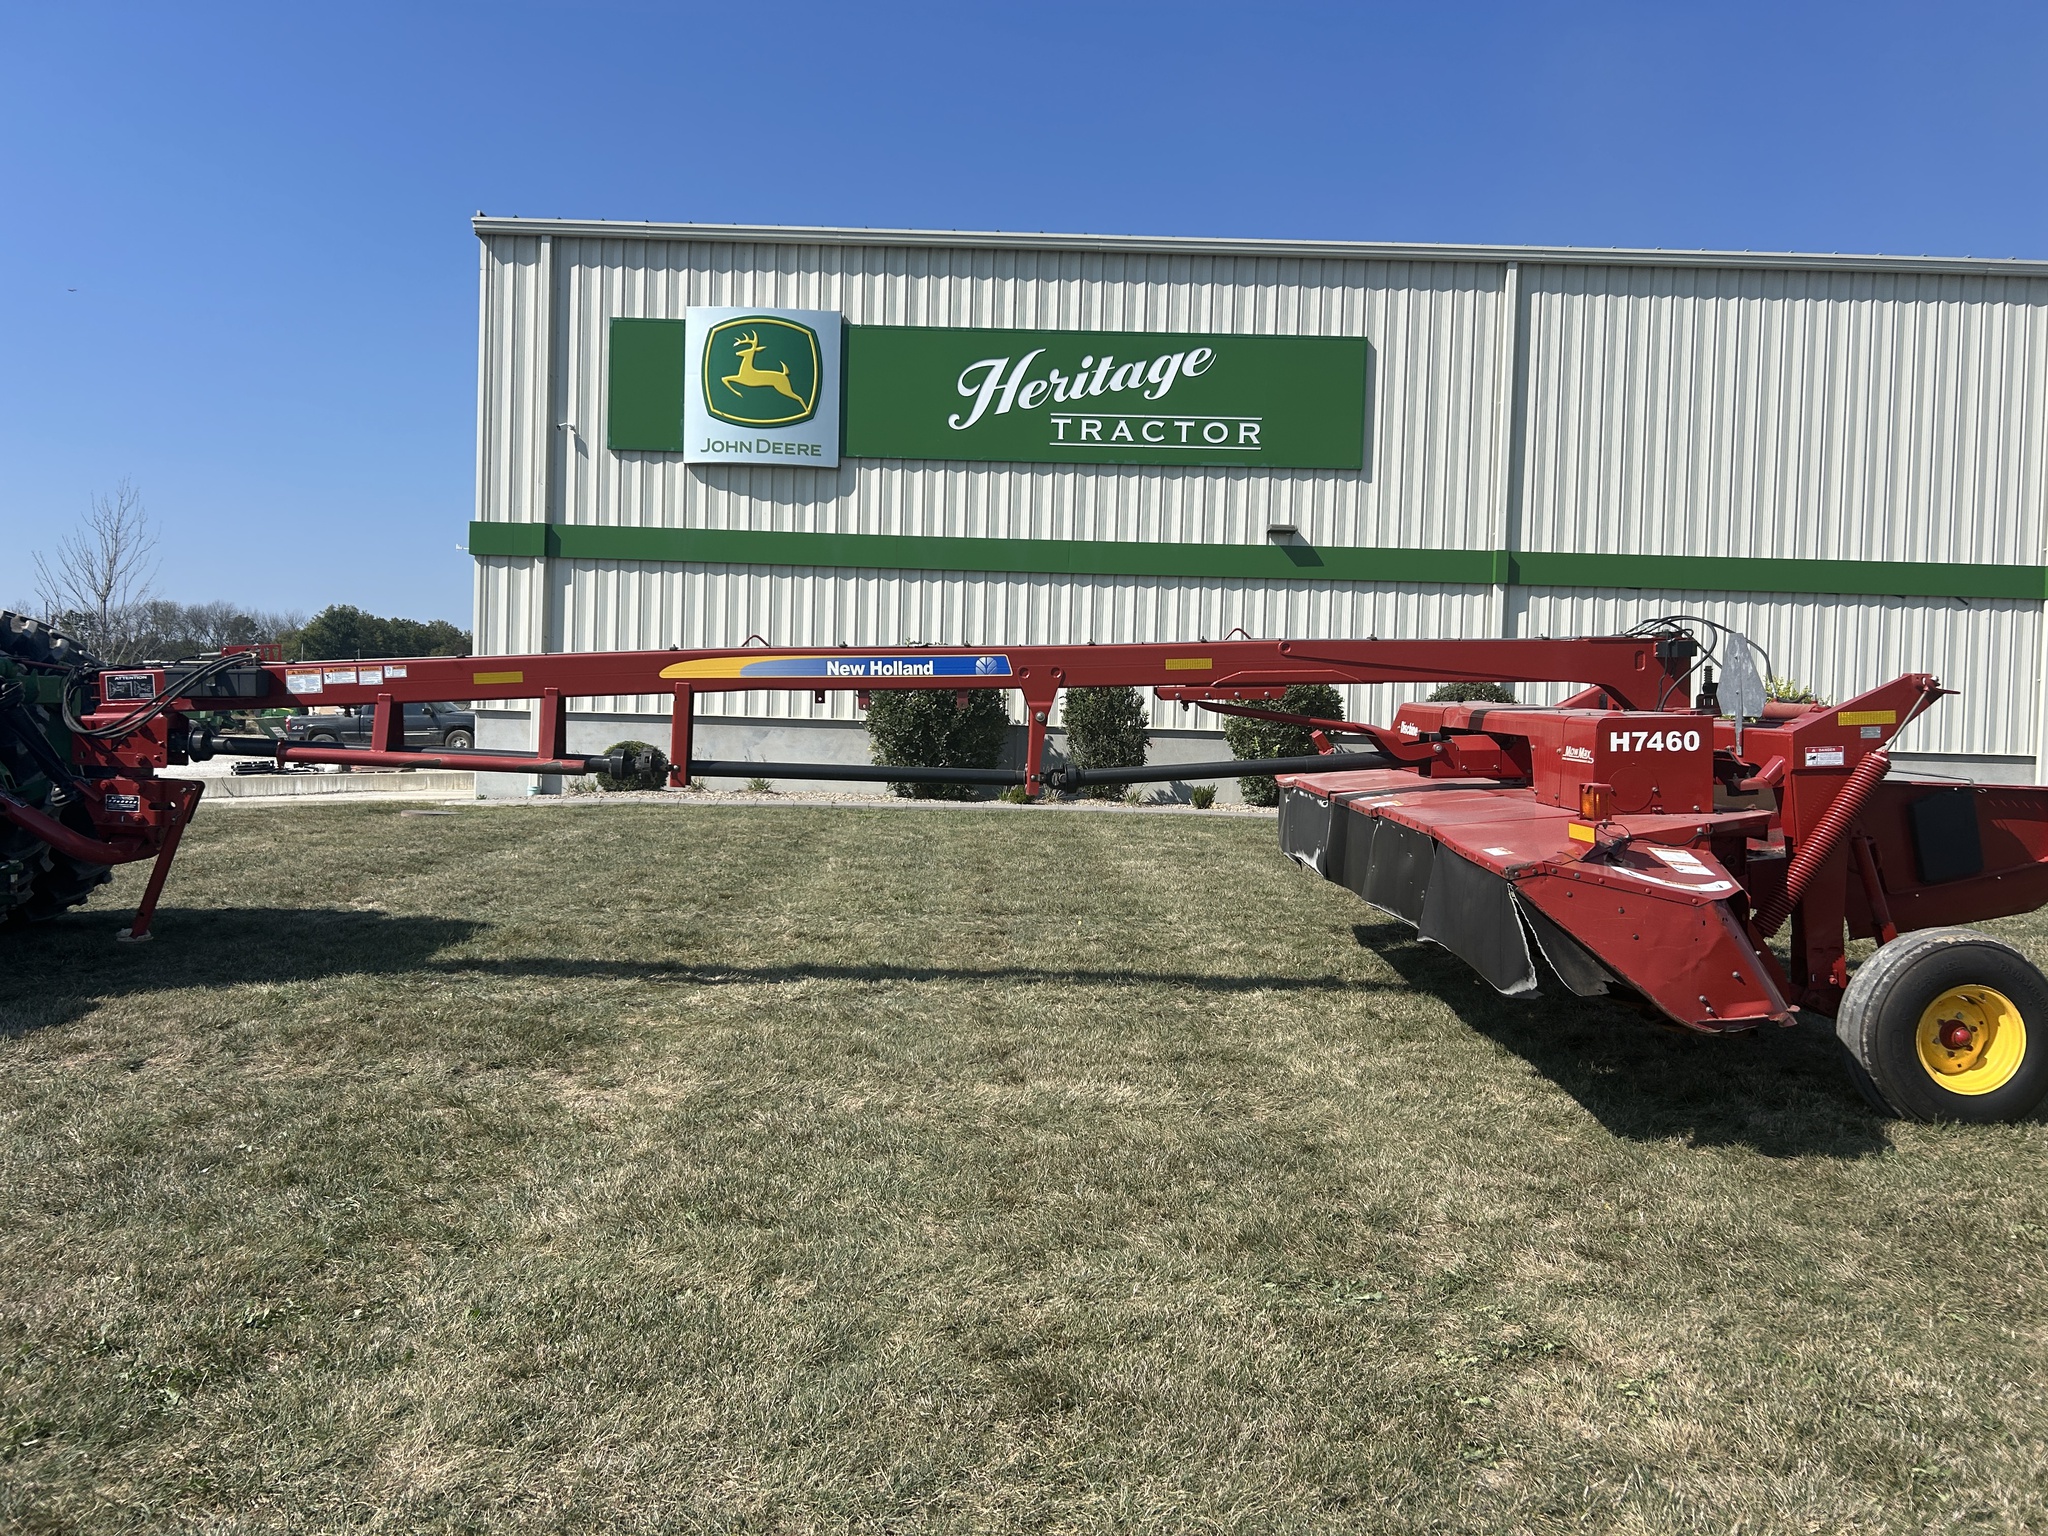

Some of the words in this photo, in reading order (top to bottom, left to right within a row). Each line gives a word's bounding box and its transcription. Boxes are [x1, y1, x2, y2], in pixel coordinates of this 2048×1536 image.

[948, 347, 1217, 430] Heritage
[1050, 417, 1262, 445] TRACTOR
[700, 437, 752, 453] JOHN
[756, 438, 822, 457] DEERE
[826, 660, 865, 676] New
[869, 660, 934, 676] Holland
[1609, 730, 1701, 752] H7460
